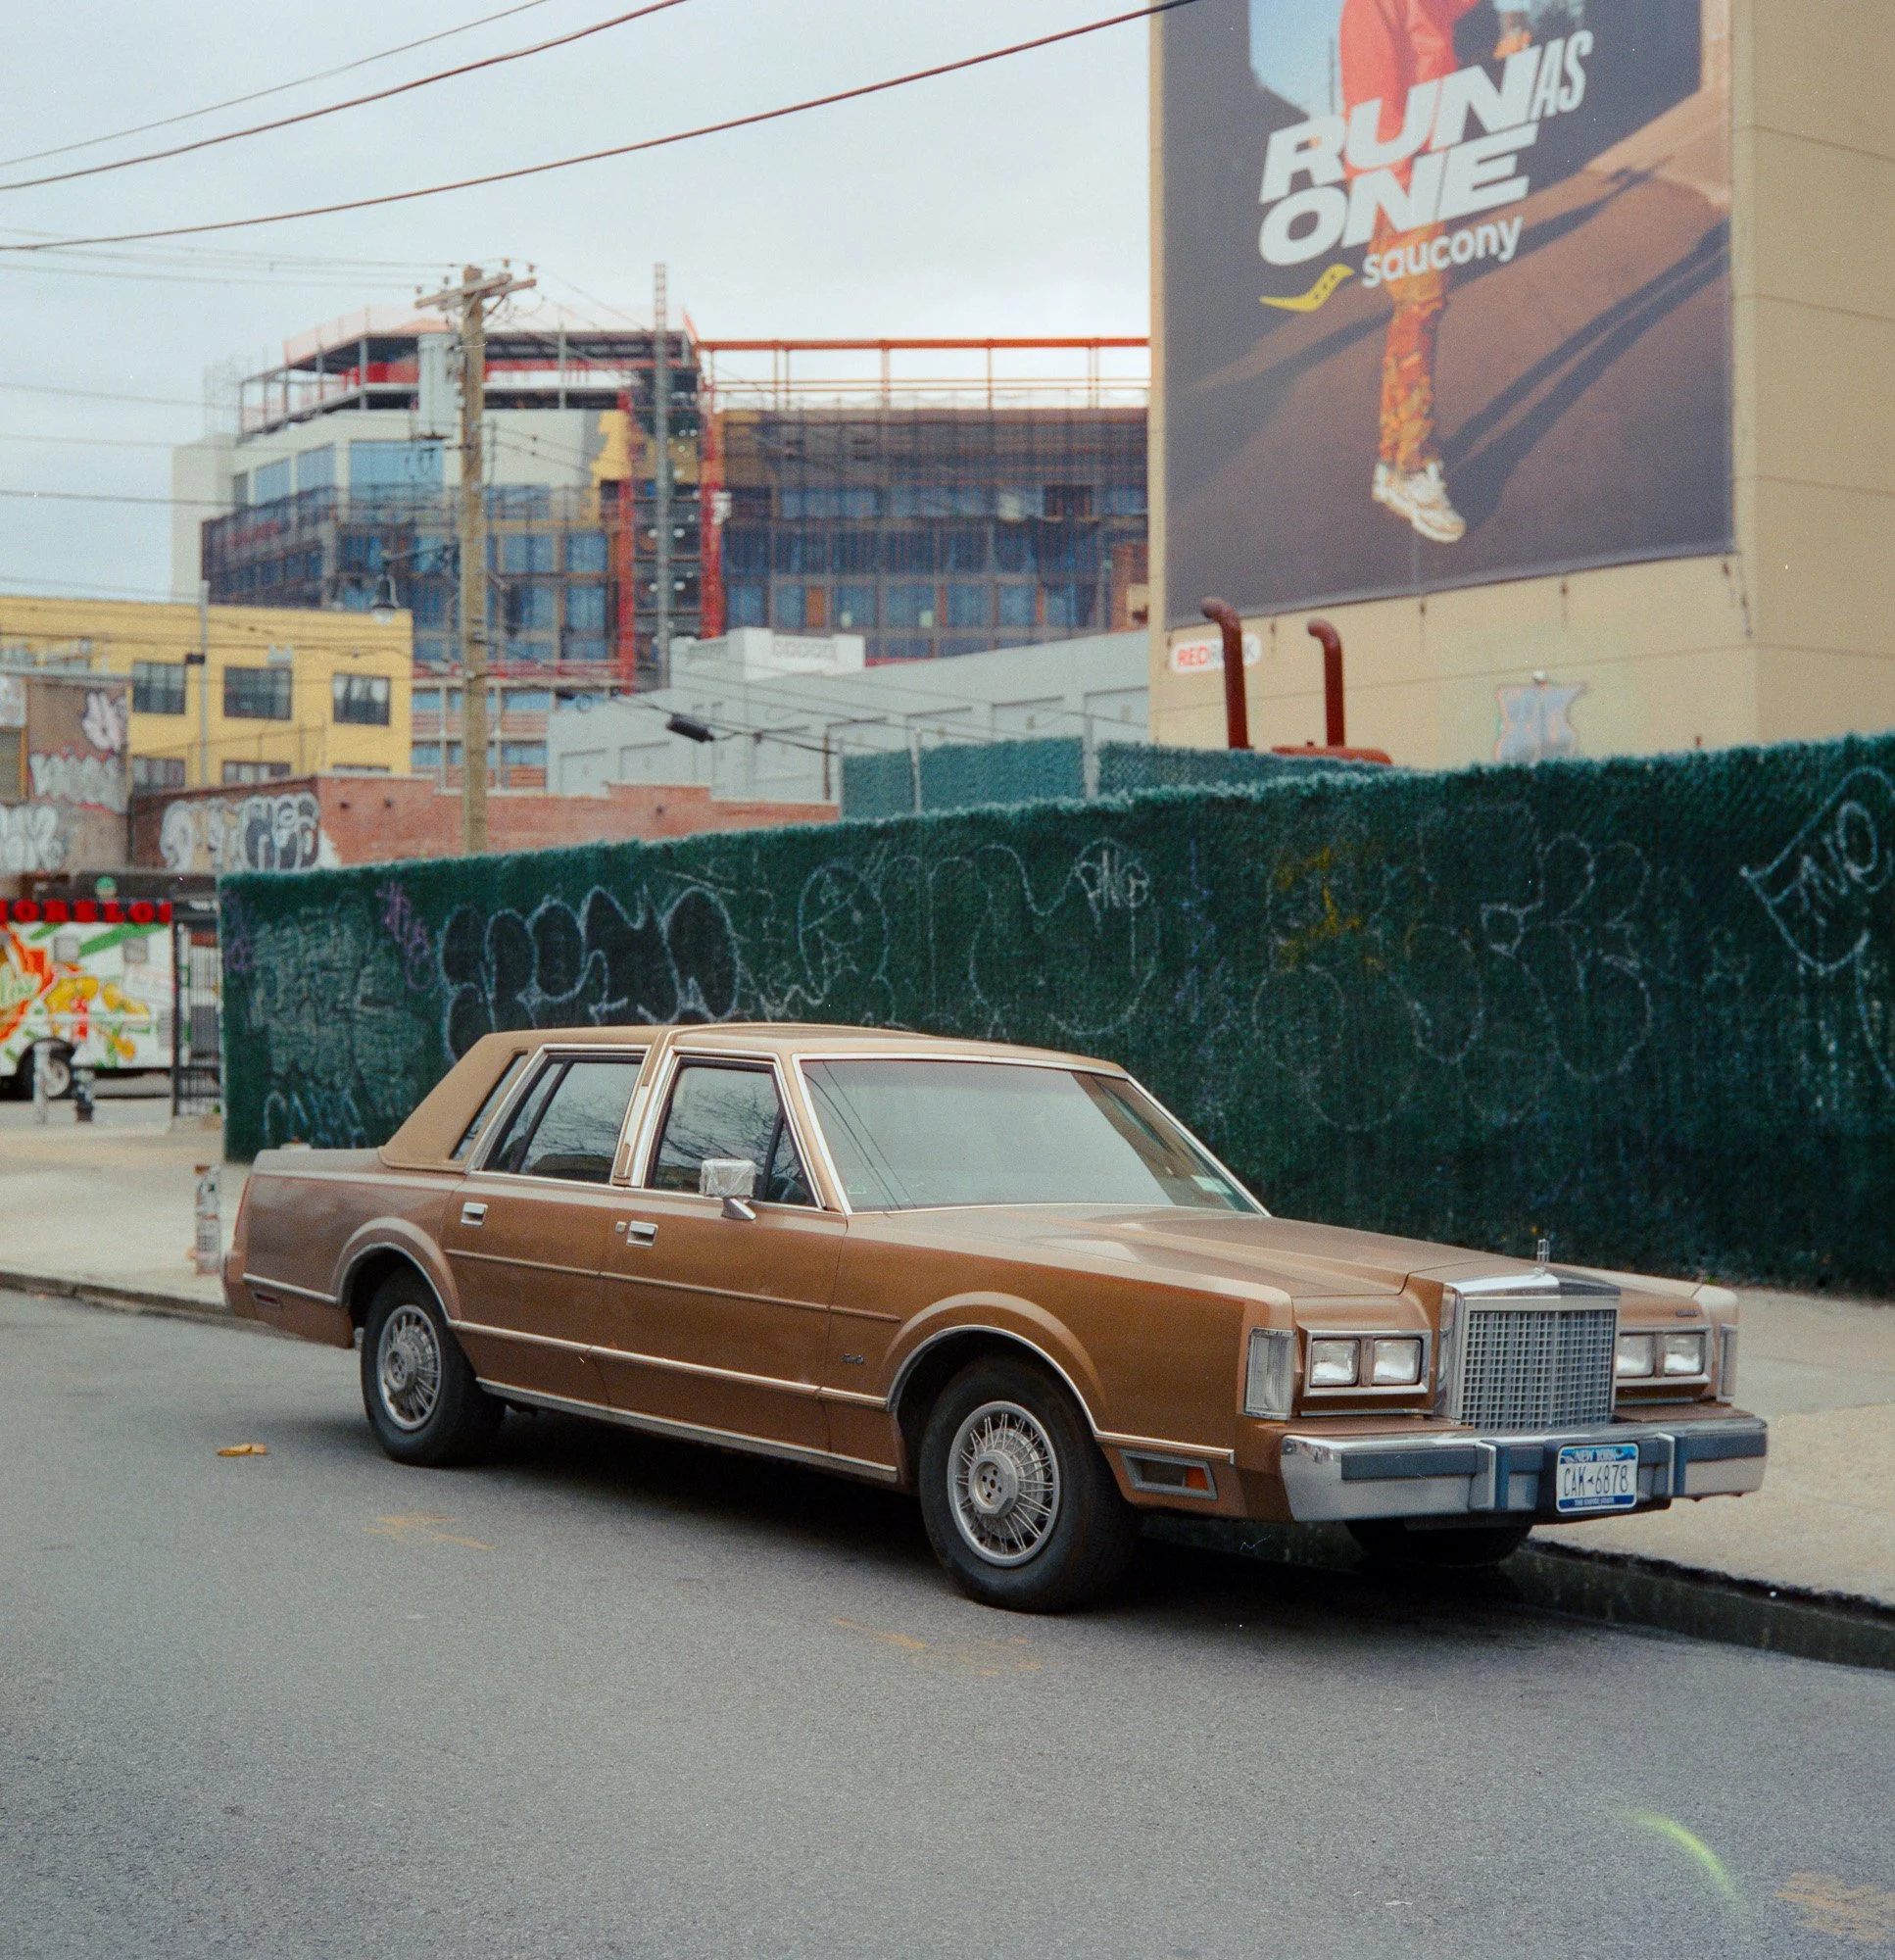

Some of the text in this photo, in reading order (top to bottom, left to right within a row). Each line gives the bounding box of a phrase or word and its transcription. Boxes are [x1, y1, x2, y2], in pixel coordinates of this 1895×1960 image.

[1259, 29, 1594, 204] RUN AS
[1258, 121, 1539, 266] ONE
[1362, 215, 1524, 288] saucony
